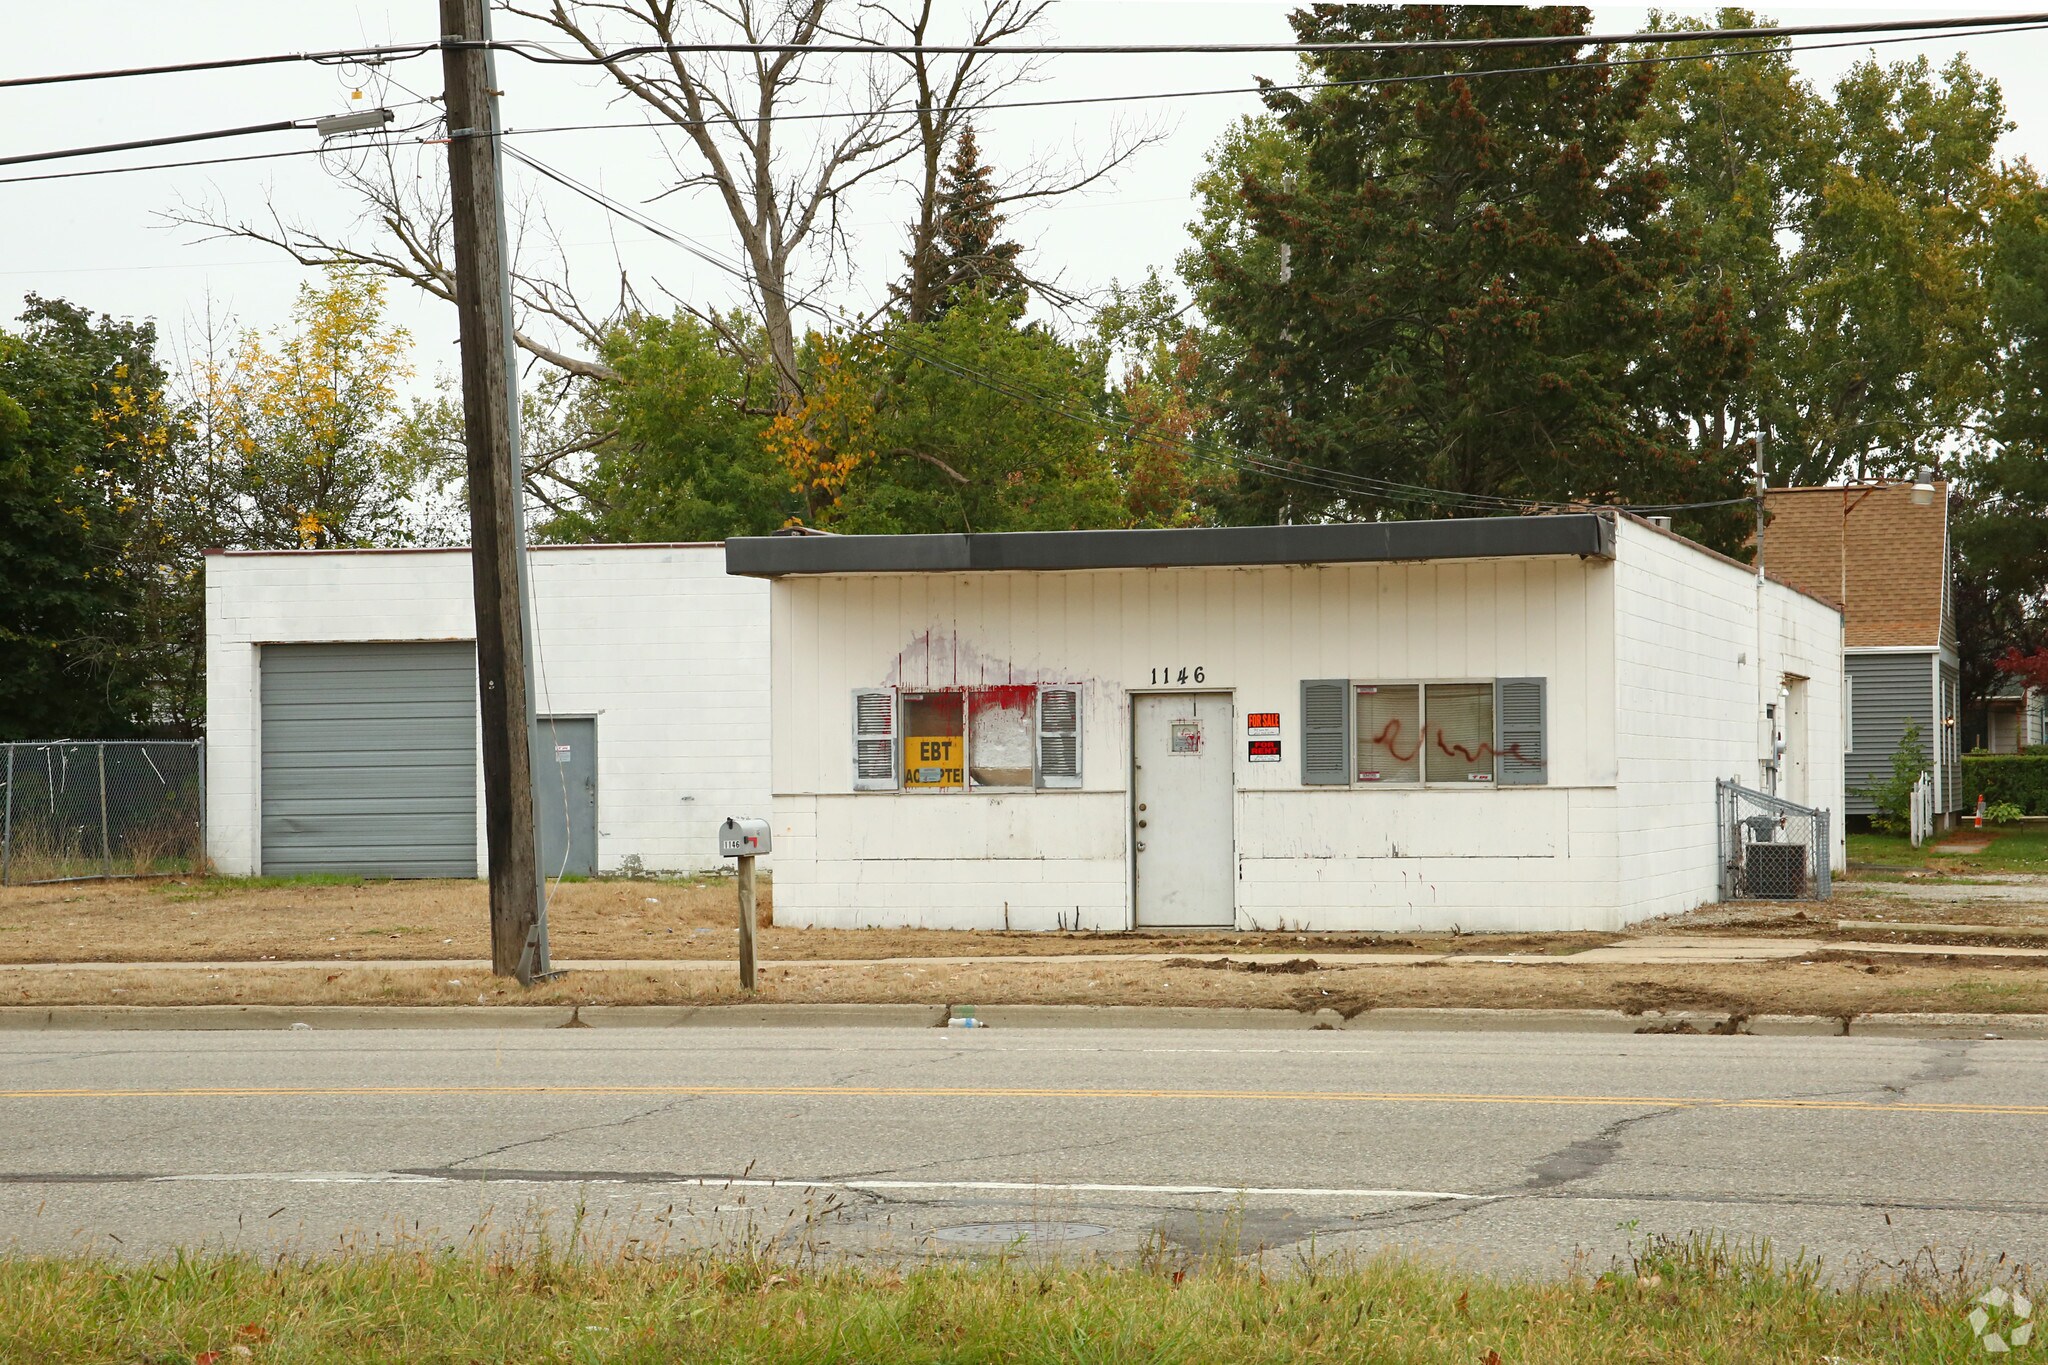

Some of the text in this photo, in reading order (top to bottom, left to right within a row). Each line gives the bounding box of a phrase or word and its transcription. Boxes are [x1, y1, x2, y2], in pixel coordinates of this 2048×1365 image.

[1151, 666, 1205, 685] 1146
[1248, 713, 1279, 727] FOR SALE
[920, 741, 952, 761] EBT
[1251, 747, 1279, 755] RENT
[724, 840, 740, 849] 1146
